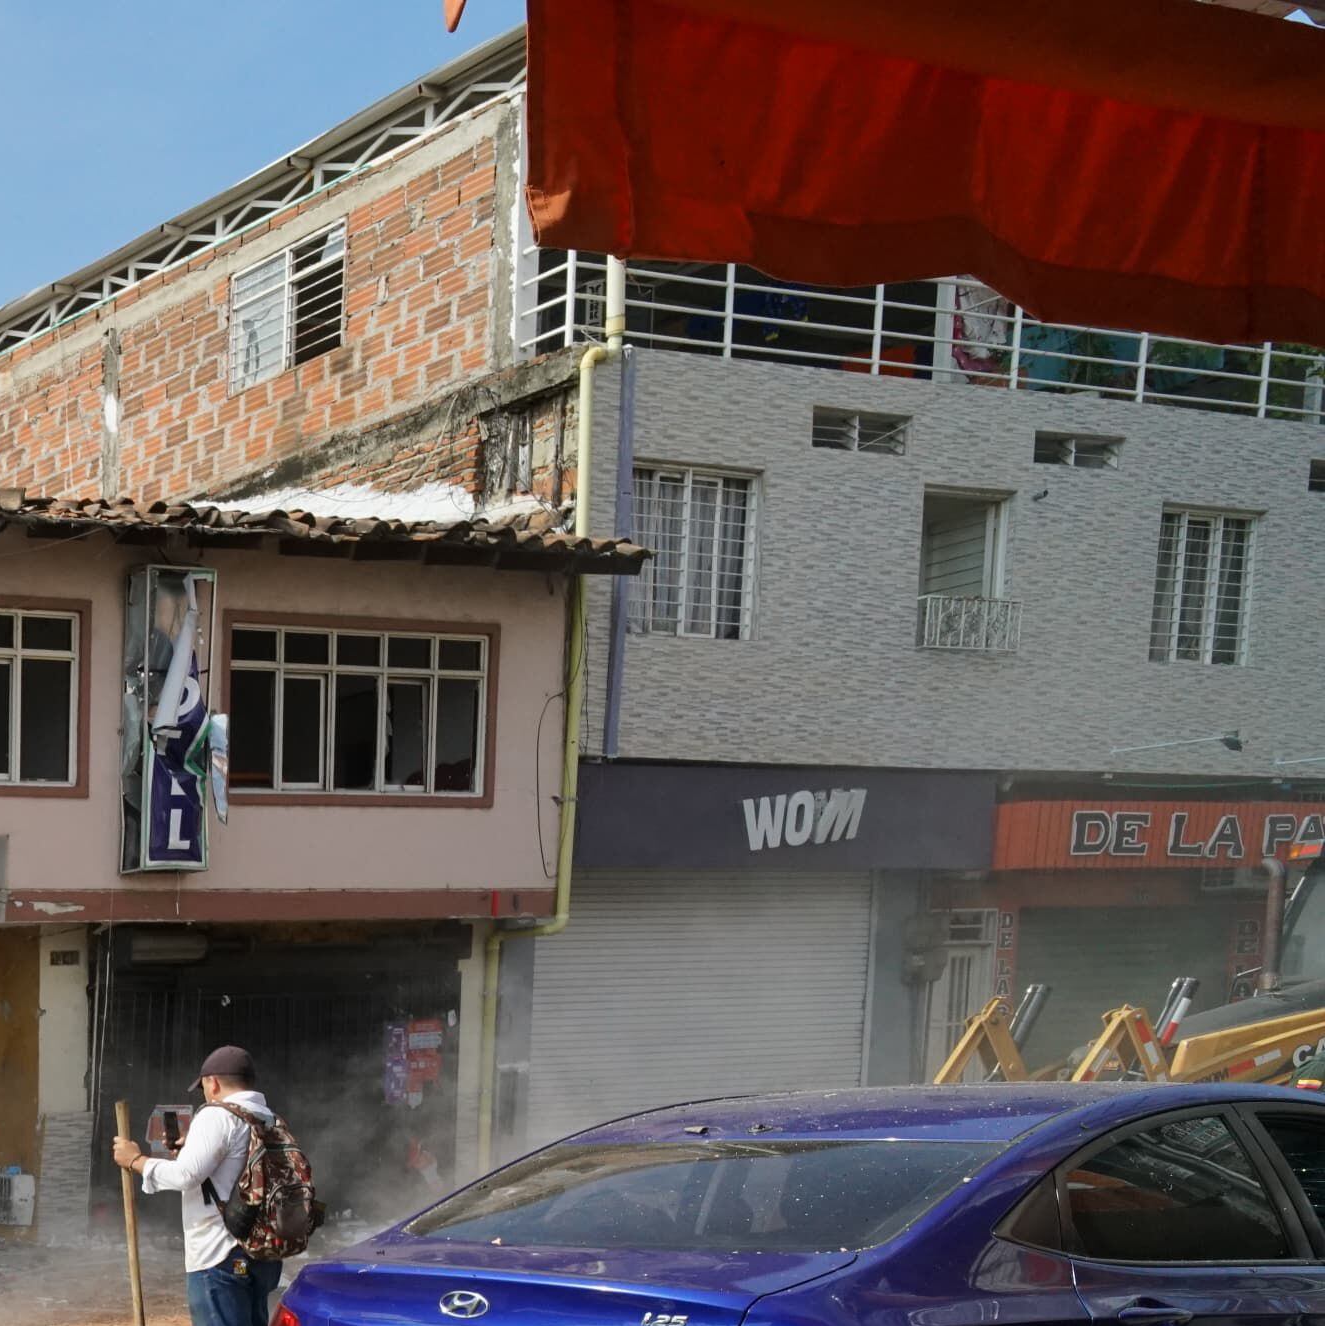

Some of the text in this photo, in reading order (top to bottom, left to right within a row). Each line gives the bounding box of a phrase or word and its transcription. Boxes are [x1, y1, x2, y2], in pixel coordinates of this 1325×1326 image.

[743, 788, 867, 851] WOM
[1070, 810, 1150, 856] DE
[1167, 812, 1244, 858] LA
